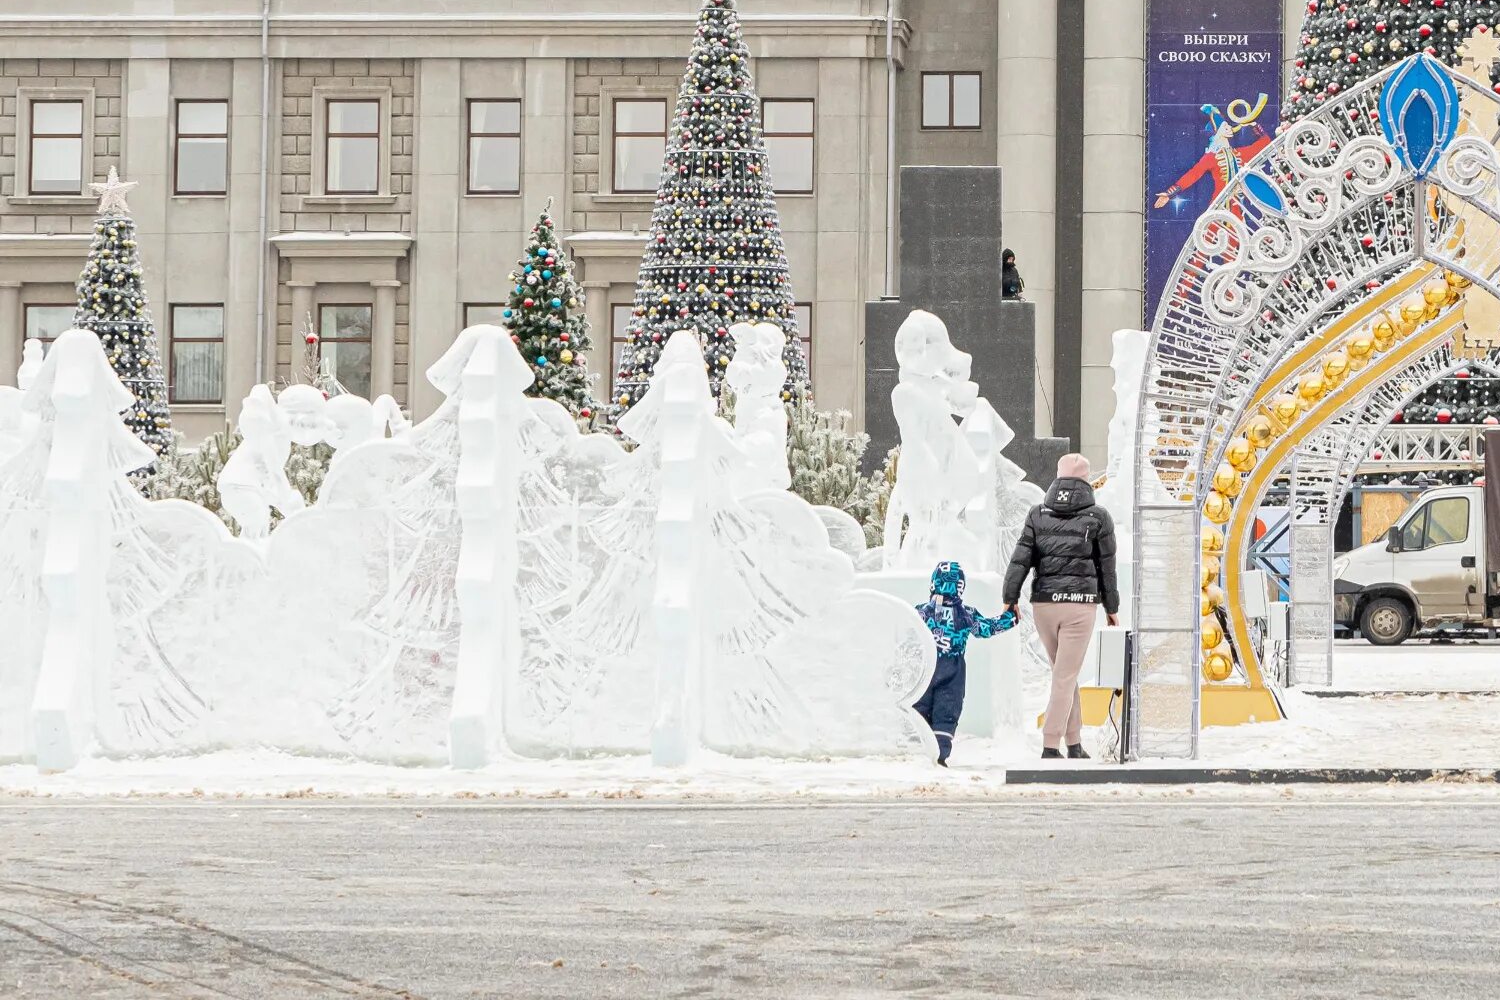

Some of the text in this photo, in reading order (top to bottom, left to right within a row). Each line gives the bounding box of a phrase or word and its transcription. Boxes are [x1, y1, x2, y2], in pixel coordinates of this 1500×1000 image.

[1183, 34, 1249, 46] ВЫБЕРИ
[1158, 51, 1271, 63] СВОЮ СКАЗКУ!
[1051, 592, 1096, 603] OFF-WHTE
